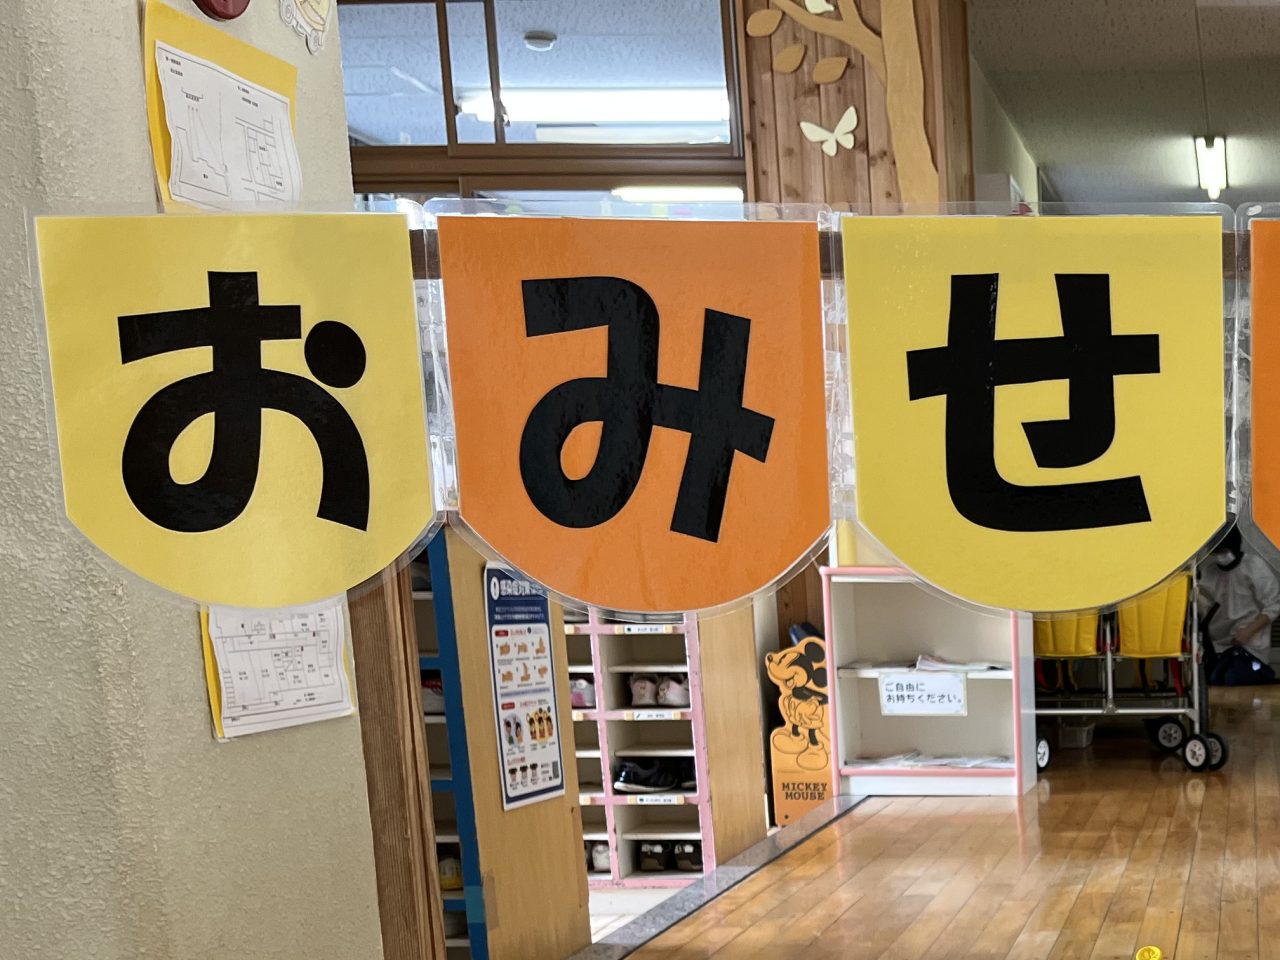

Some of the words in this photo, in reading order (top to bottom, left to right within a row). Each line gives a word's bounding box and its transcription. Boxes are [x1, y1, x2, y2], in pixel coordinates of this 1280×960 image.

[885, 682, 925, 692] ご自由に
[886, 694, 962, 704] お持ちください。
[781, 782, 828, 792] MICKEY
[785, 792, 825, 801] MOUSE
